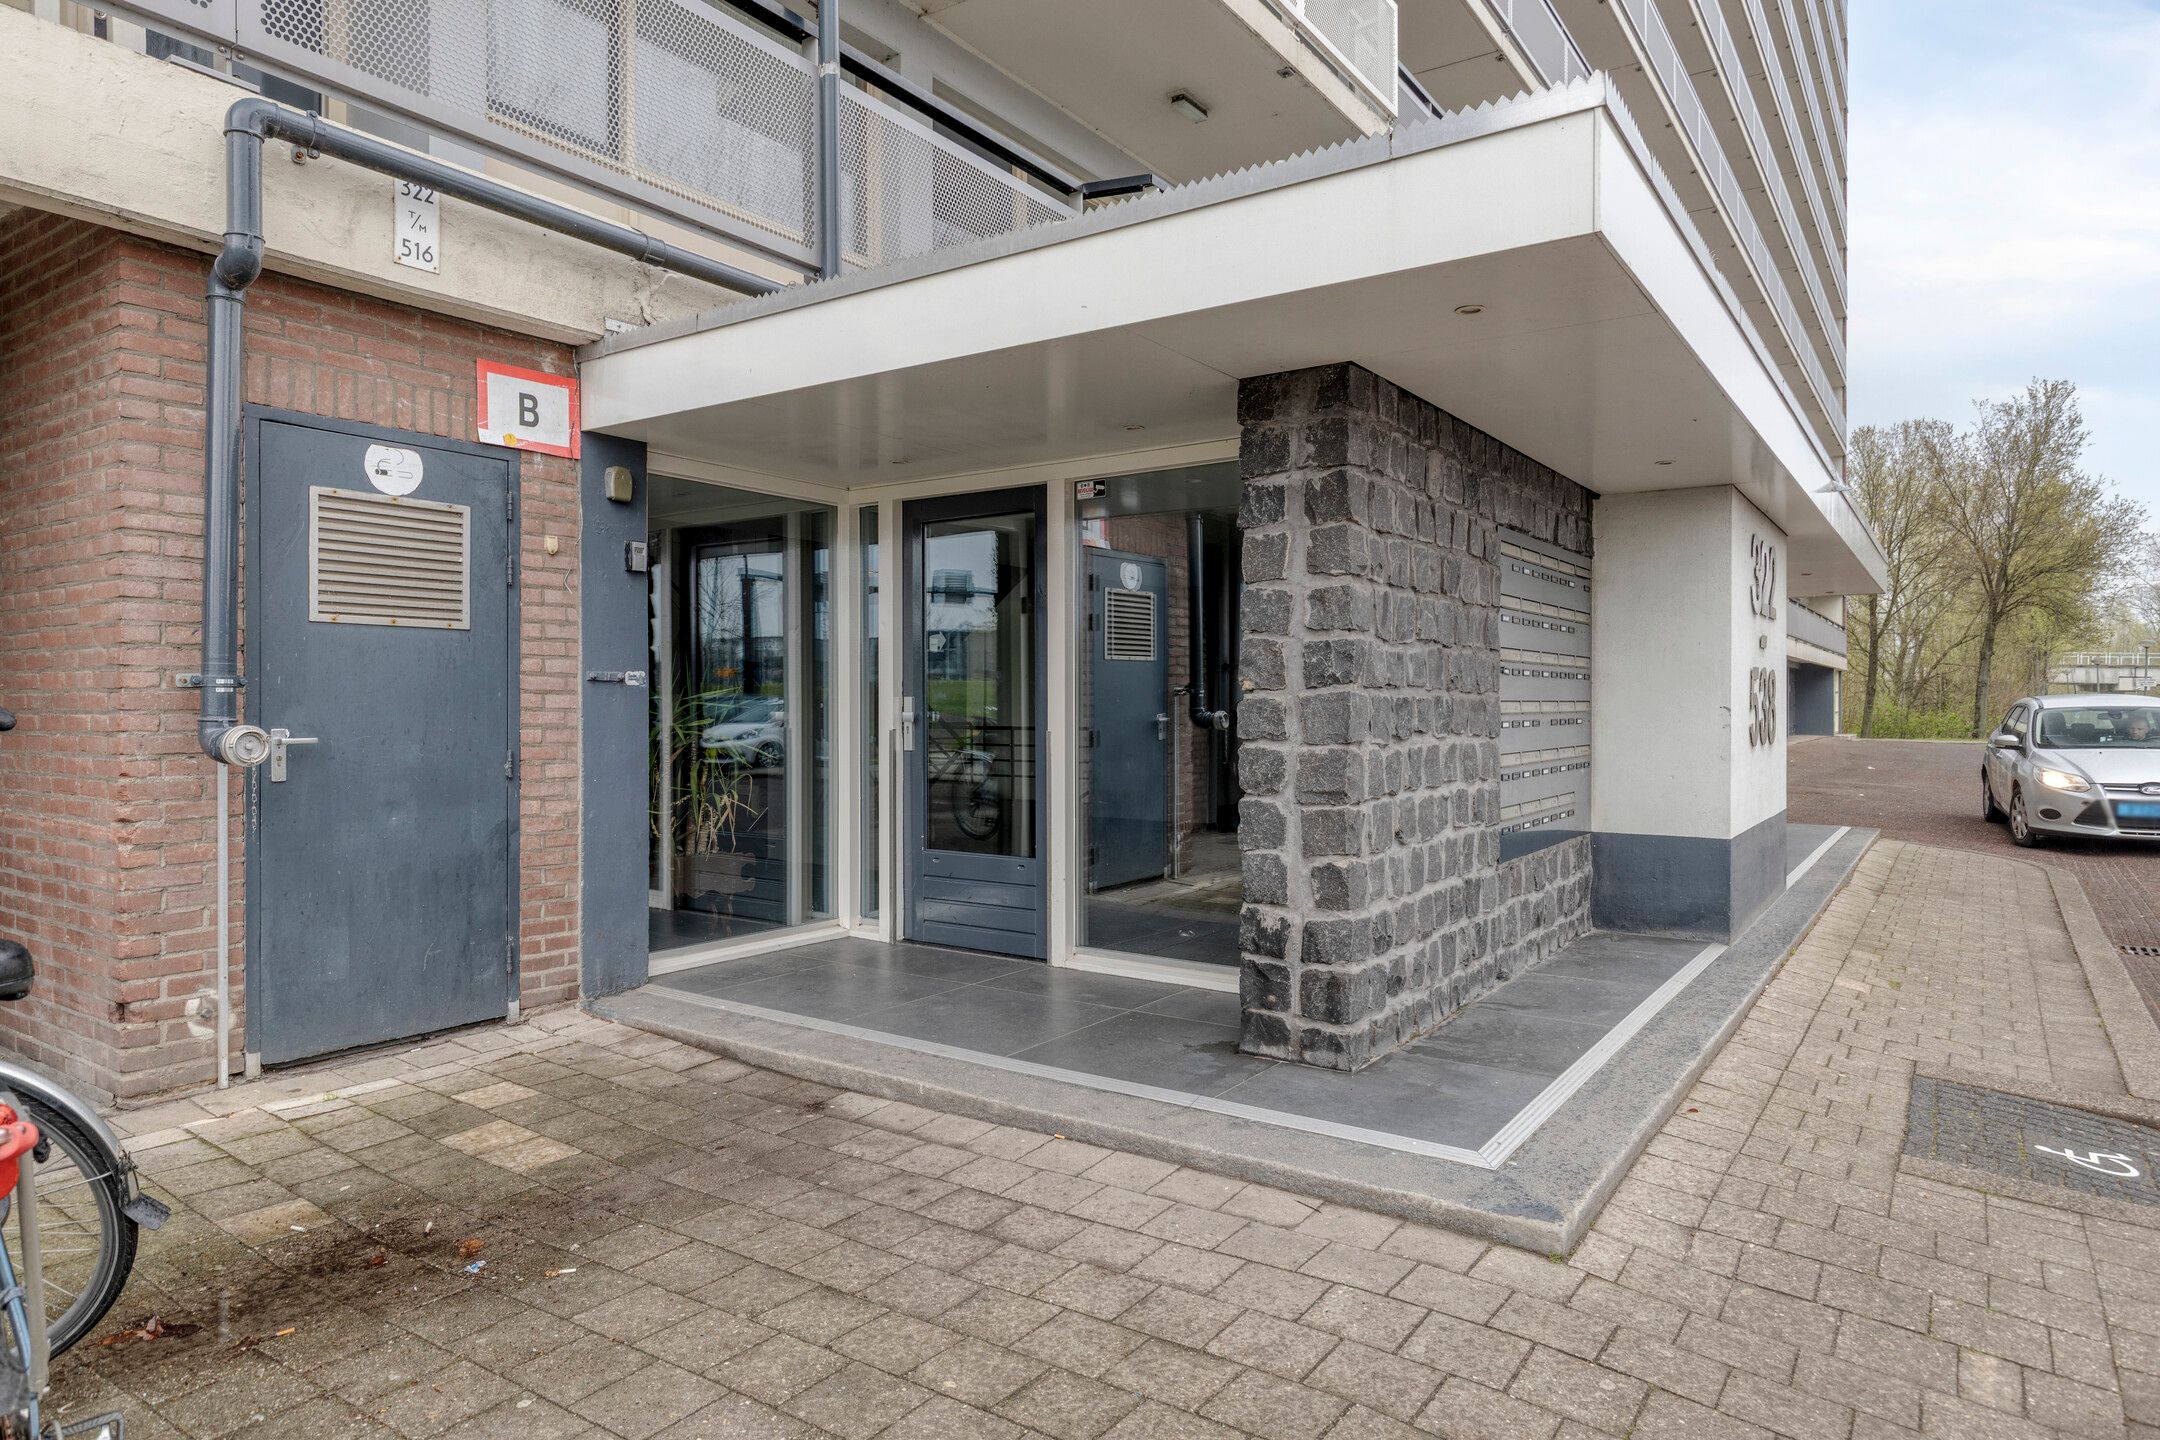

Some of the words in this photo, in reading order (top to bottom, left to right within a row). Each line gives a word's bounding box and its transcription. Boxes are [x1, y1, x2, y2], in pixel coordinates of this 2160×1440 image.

[401, 181, 434, 205] 322
[401, 238, 434, 263] 516
[519, 392, 540, 428] B
[1750, 533, 1777, 621] 322
[1749, 667, 1777, 747] 538
